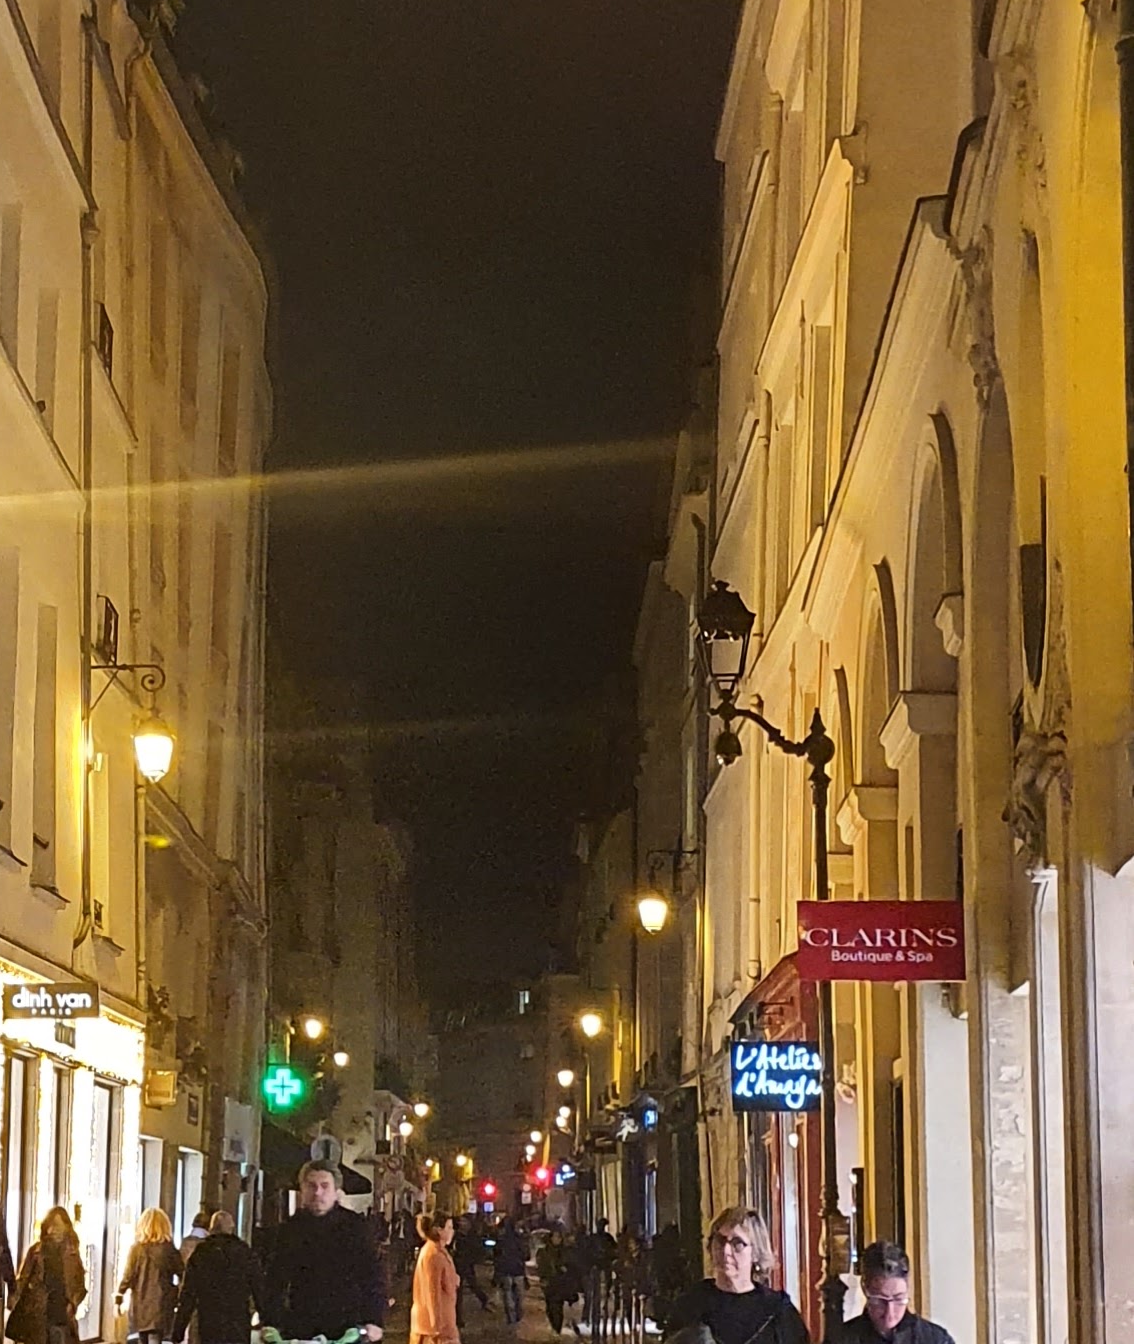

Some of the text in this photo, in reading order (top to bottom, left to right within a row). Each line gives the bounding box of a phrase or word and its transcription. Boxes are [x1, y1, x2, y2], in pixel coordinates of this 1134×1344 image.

[805, 927, 958, 948] CLARINS
[831, 949, 934, 964] Boutique & Spa
[12, 986, 92, 1008] dinh van
